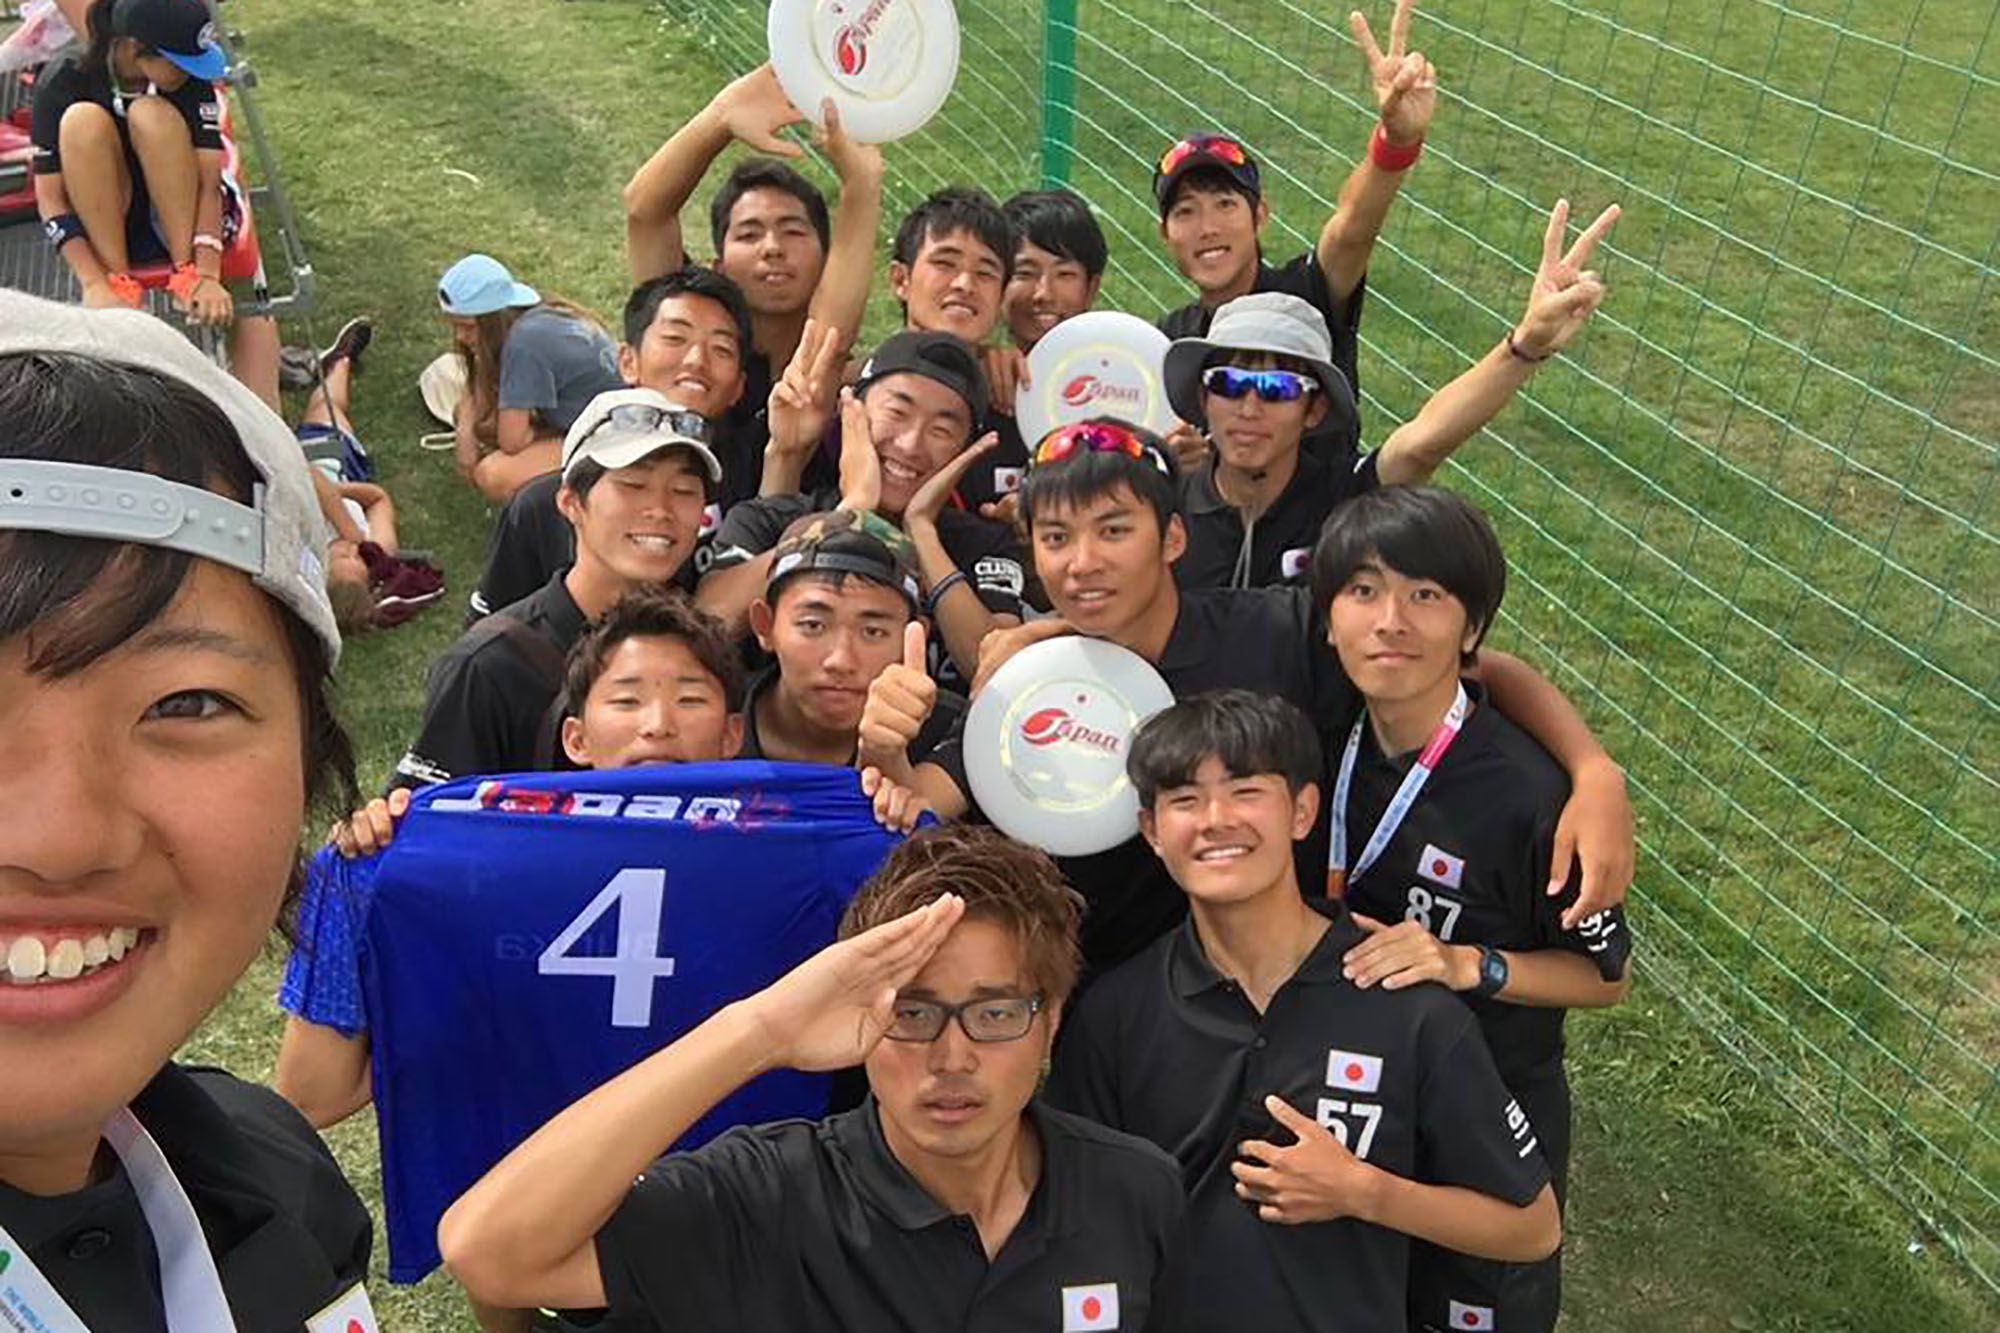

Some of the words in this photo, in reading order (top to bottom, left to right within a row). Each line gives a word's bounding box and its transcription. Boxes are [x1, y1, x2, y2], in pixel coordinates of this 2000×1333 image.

[1021, 707, 1120, 754] Japan
[1406, 886, 1462, 941] 87
[538, 868, 674, 1027] 4
[1316, 1098, 1383, 1158] 57
